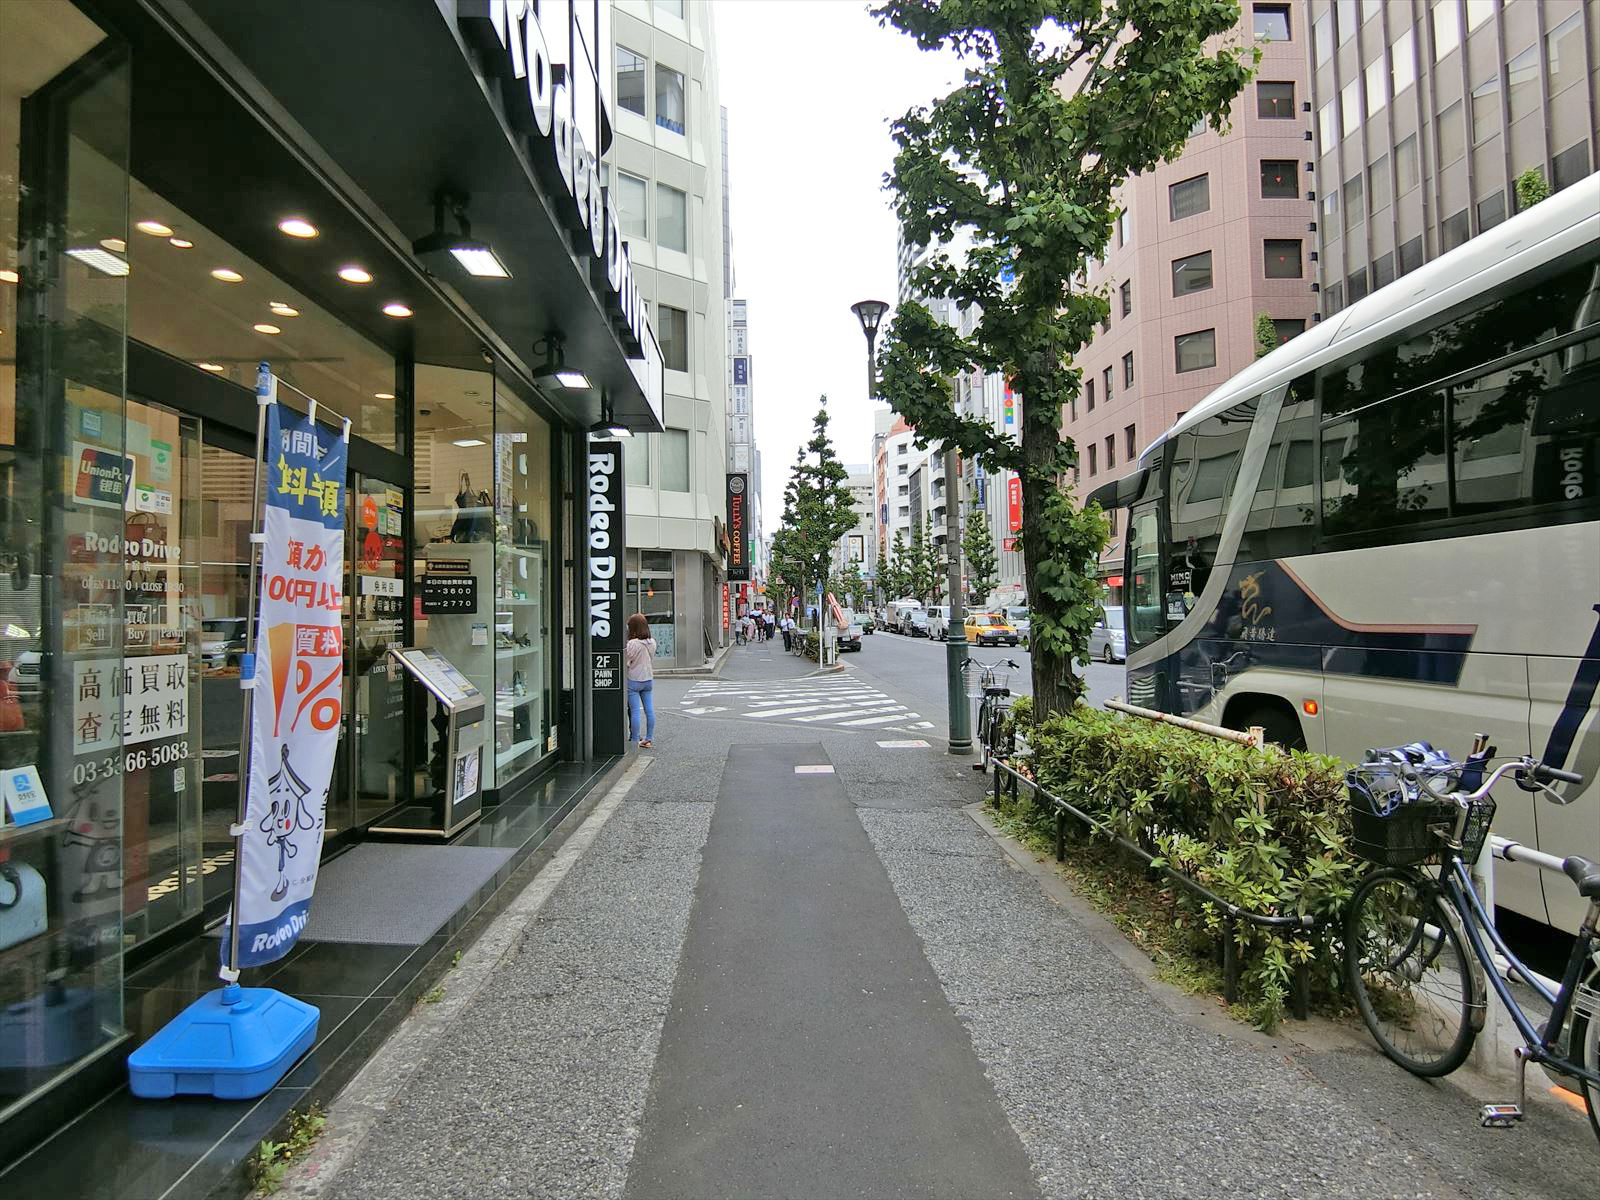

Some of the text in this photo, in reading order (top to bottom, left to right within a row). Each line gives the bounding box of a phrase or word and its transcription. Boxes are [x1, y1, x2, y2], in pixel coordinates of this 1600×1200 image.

[85, 532, 181, 559] Rodeo Drive
[589, 452, 617, 638] Rodeo Drive
[733, 530, 741, 565] COFFEE
[1170, 571, 1190, 581] HINO
[142, 582, 163, 592] CLOSE
[86, 628, 105, 641] Sell
[128, 628, 146, 642] Buy
[161, 628, 184, 638] Pawn
[596, 655, 611, 668] 2F
[594, 669, 613, 678] PAWN
[78, 662, 186, 702] 高価買取
[594, 679, 613, 687] SHOP
[77, 698, 186, 746] 査定無料
[251, 922, 292, 953] Rodeo
